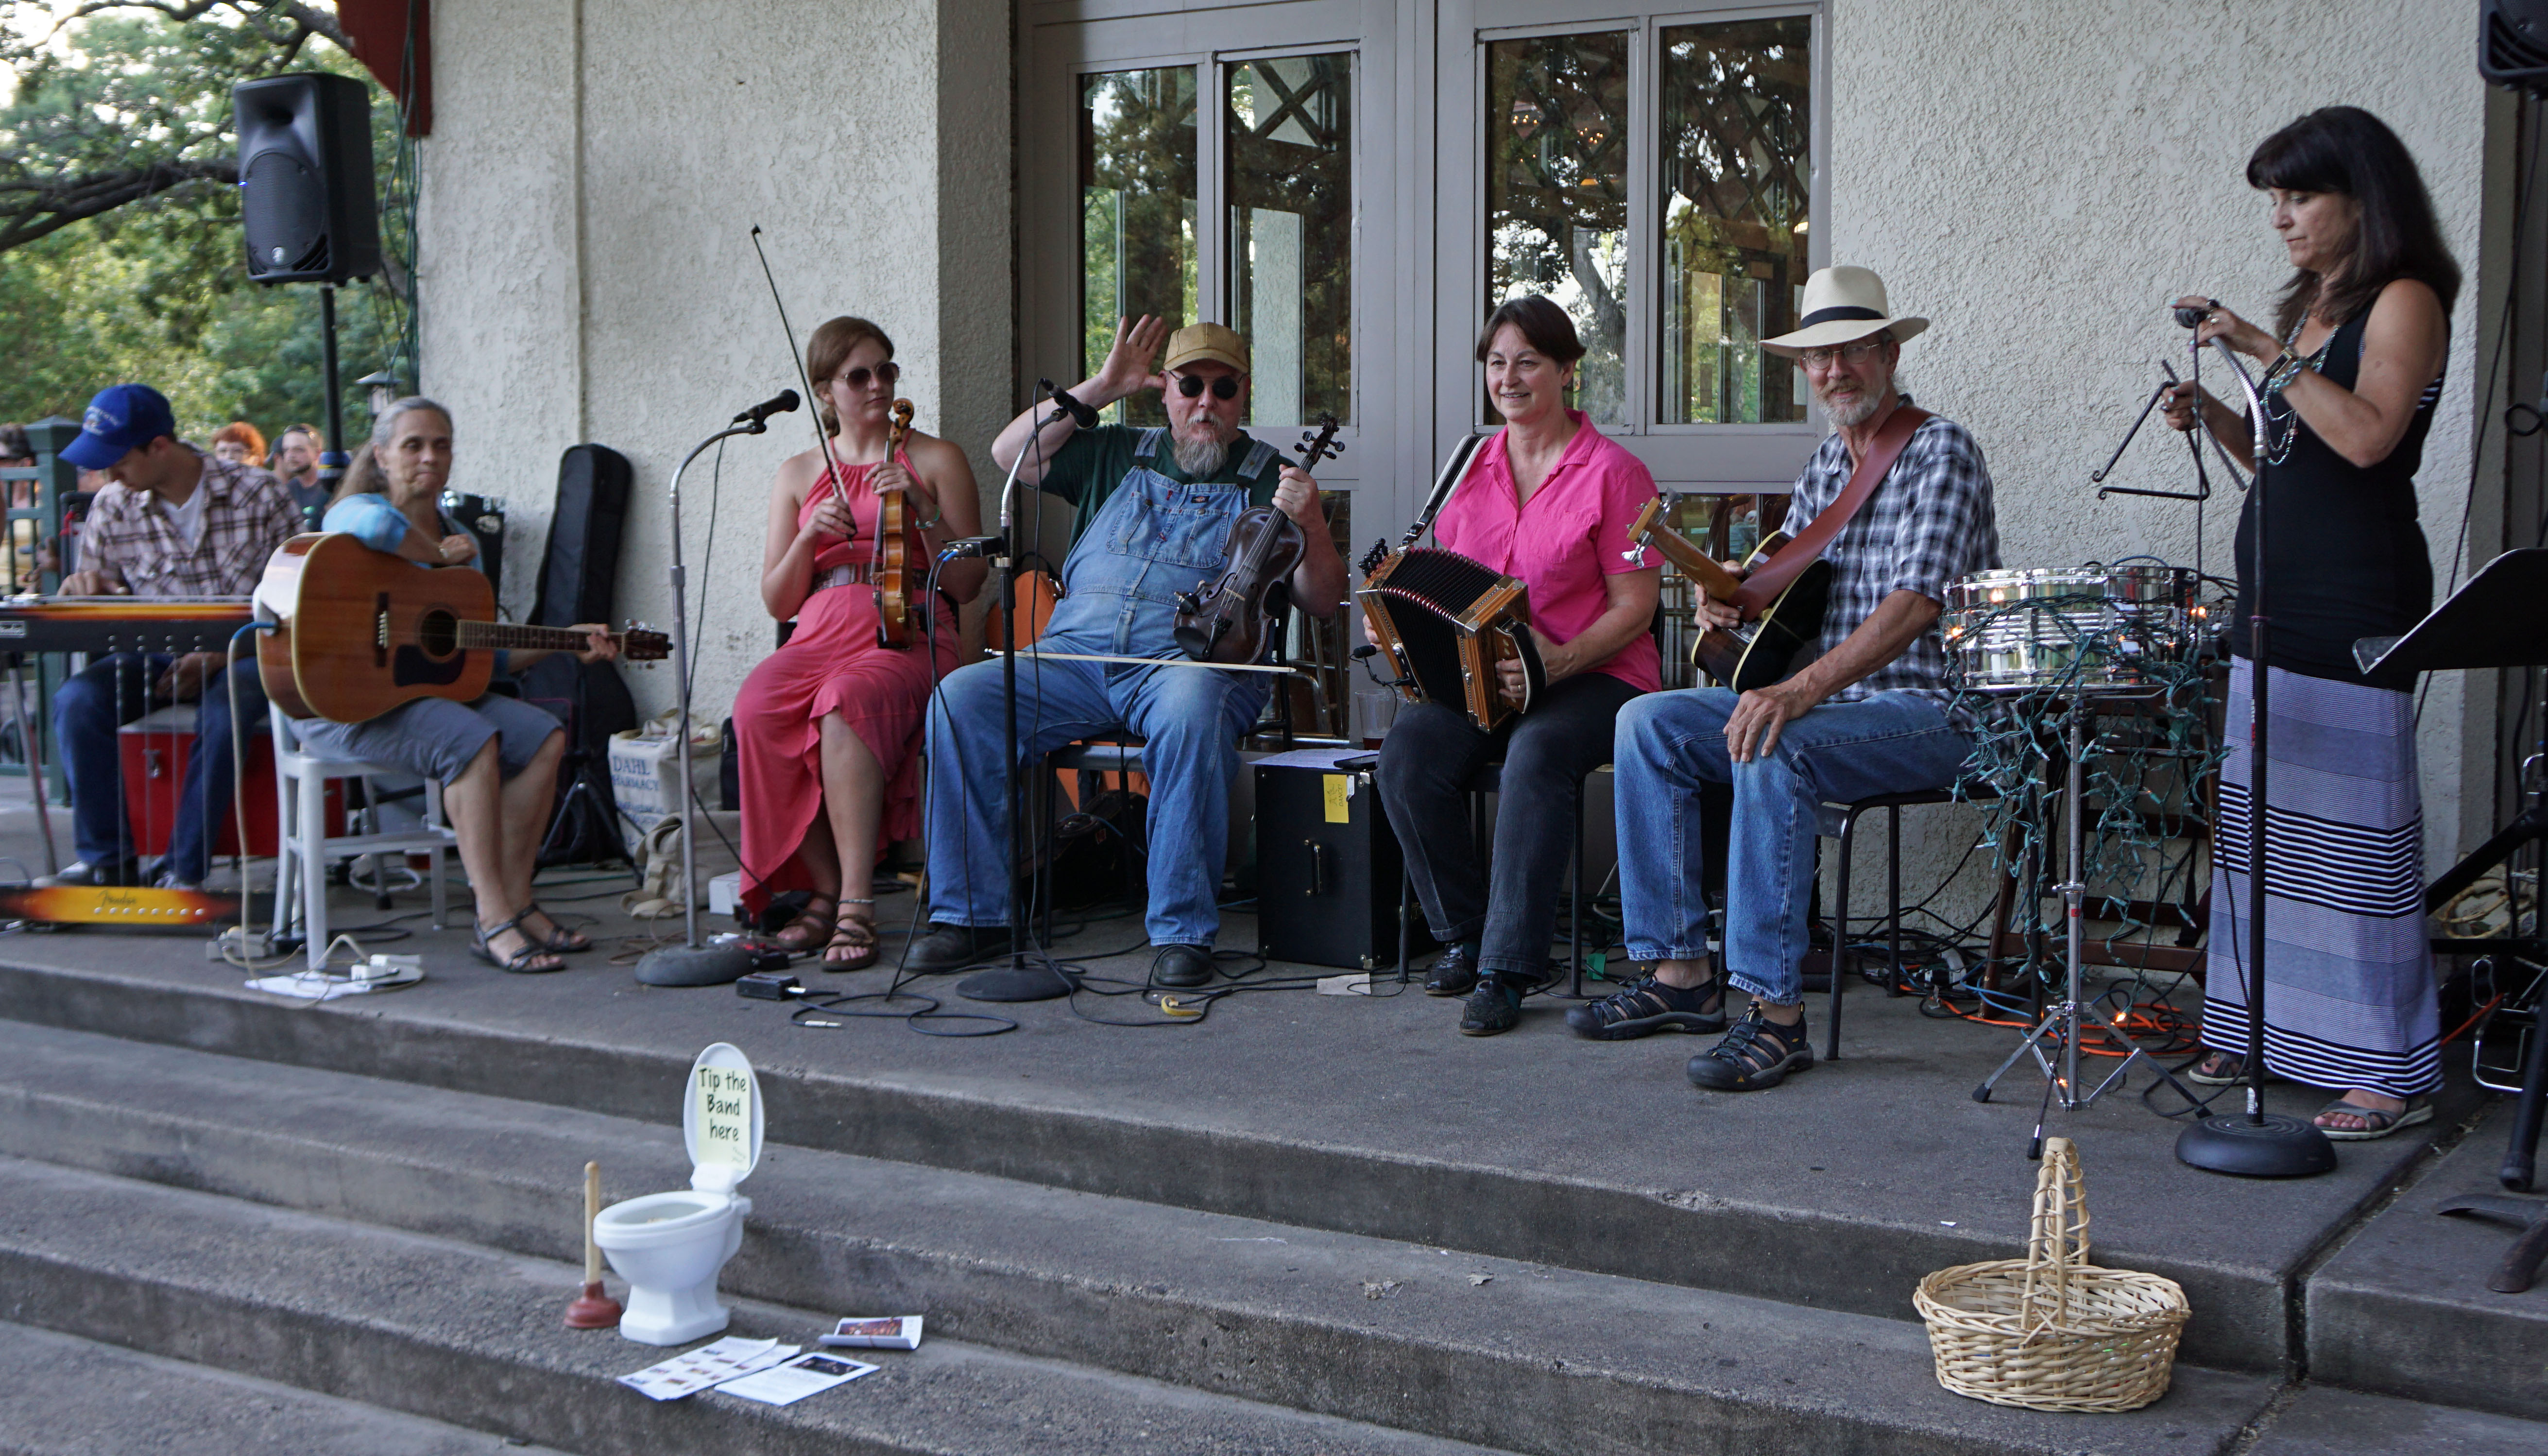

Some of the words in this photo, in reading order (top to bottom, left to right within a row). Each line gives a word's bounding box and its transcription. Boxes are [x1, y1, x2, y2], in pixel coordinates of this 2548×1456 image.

[613, 756, 650, 775] DAHL
[699, 1067, 720, 1091] Tip
[725, 1070, 746, 1092] the
[707, 1094, 740, 1116] Band
[710, 1118, 739, 1142] here
